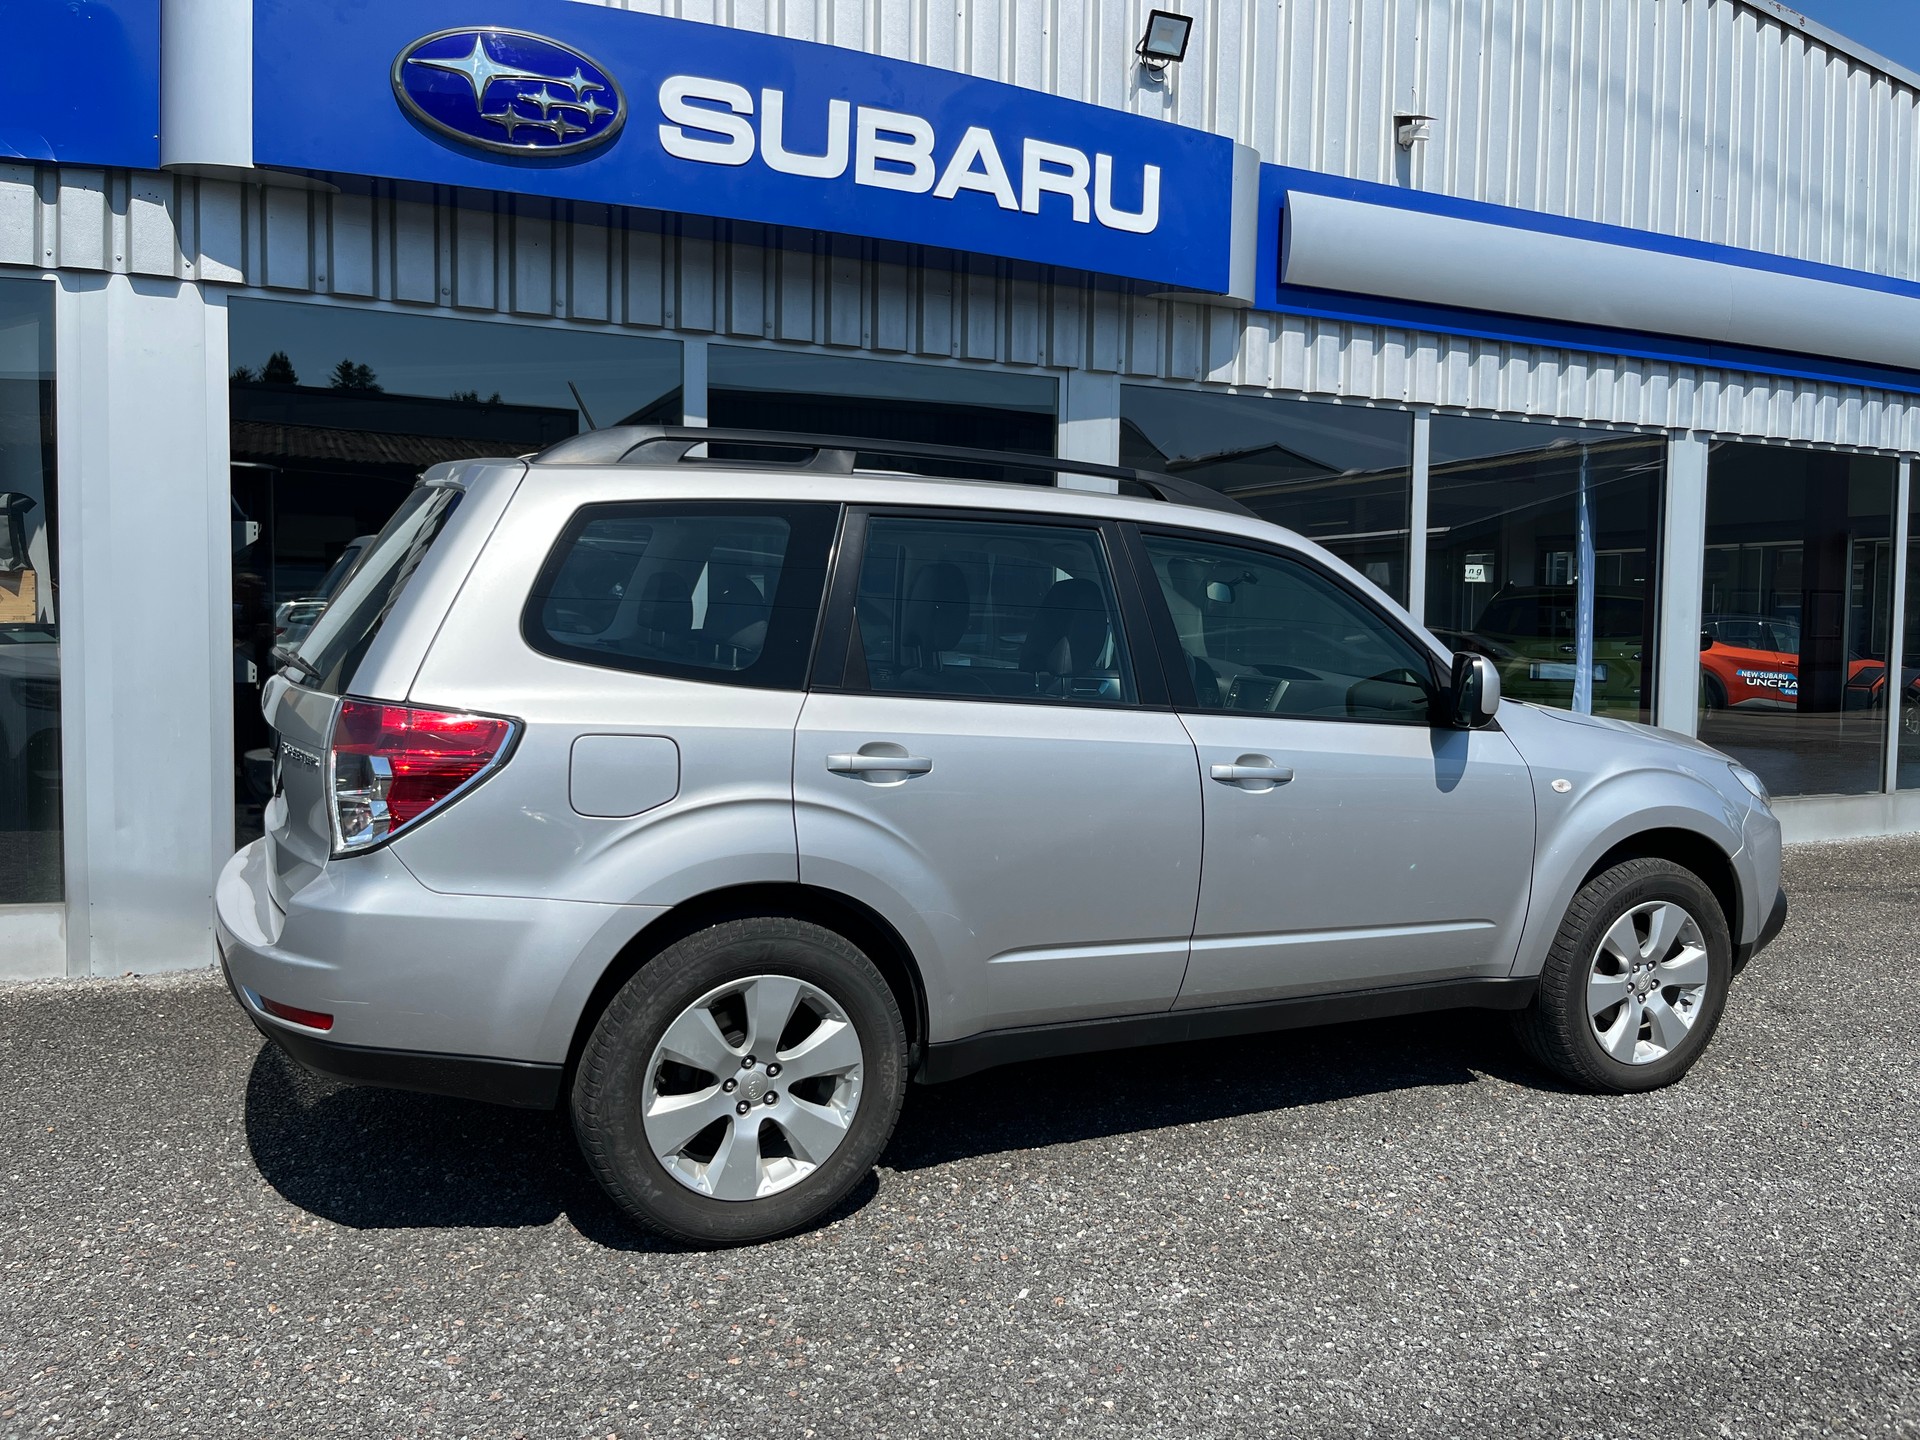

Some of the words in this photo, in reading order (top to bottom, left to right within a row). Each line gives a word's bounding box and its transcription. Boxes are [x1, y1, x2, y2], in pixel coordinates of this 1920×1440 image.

[658, 75, 1161, 234] SUBARU
[1741, 670, 1759, 678] NEW
[1760, 672, 1788, 680] SUBARU
[1746, 678, 1798, 689] UNCHA
